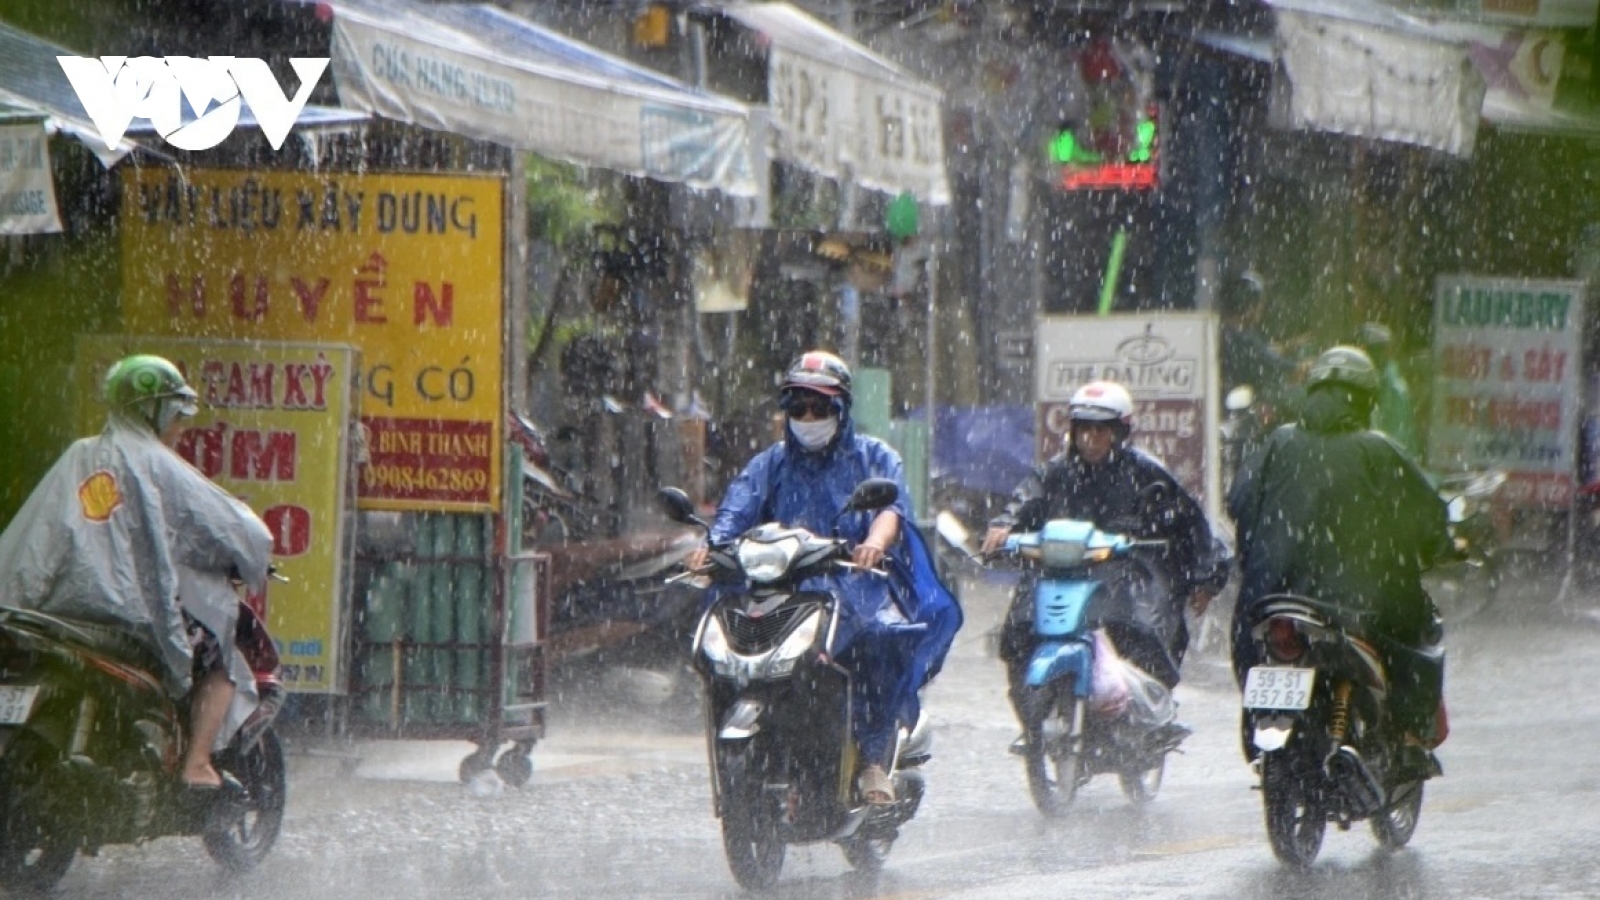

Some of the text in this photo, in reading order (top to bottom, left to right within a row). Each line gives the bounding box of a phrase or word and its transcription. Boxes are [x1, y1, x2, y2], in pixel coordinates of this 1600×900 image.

[416, 354, 474, 402] CÓ
[1101, 364, 1190, 388] DATING
[363, 463, 488, 492] 0908462869
[1257, 671, 1302, 688] 59-S1
[1247, 689, 1306, 707] 357.62
